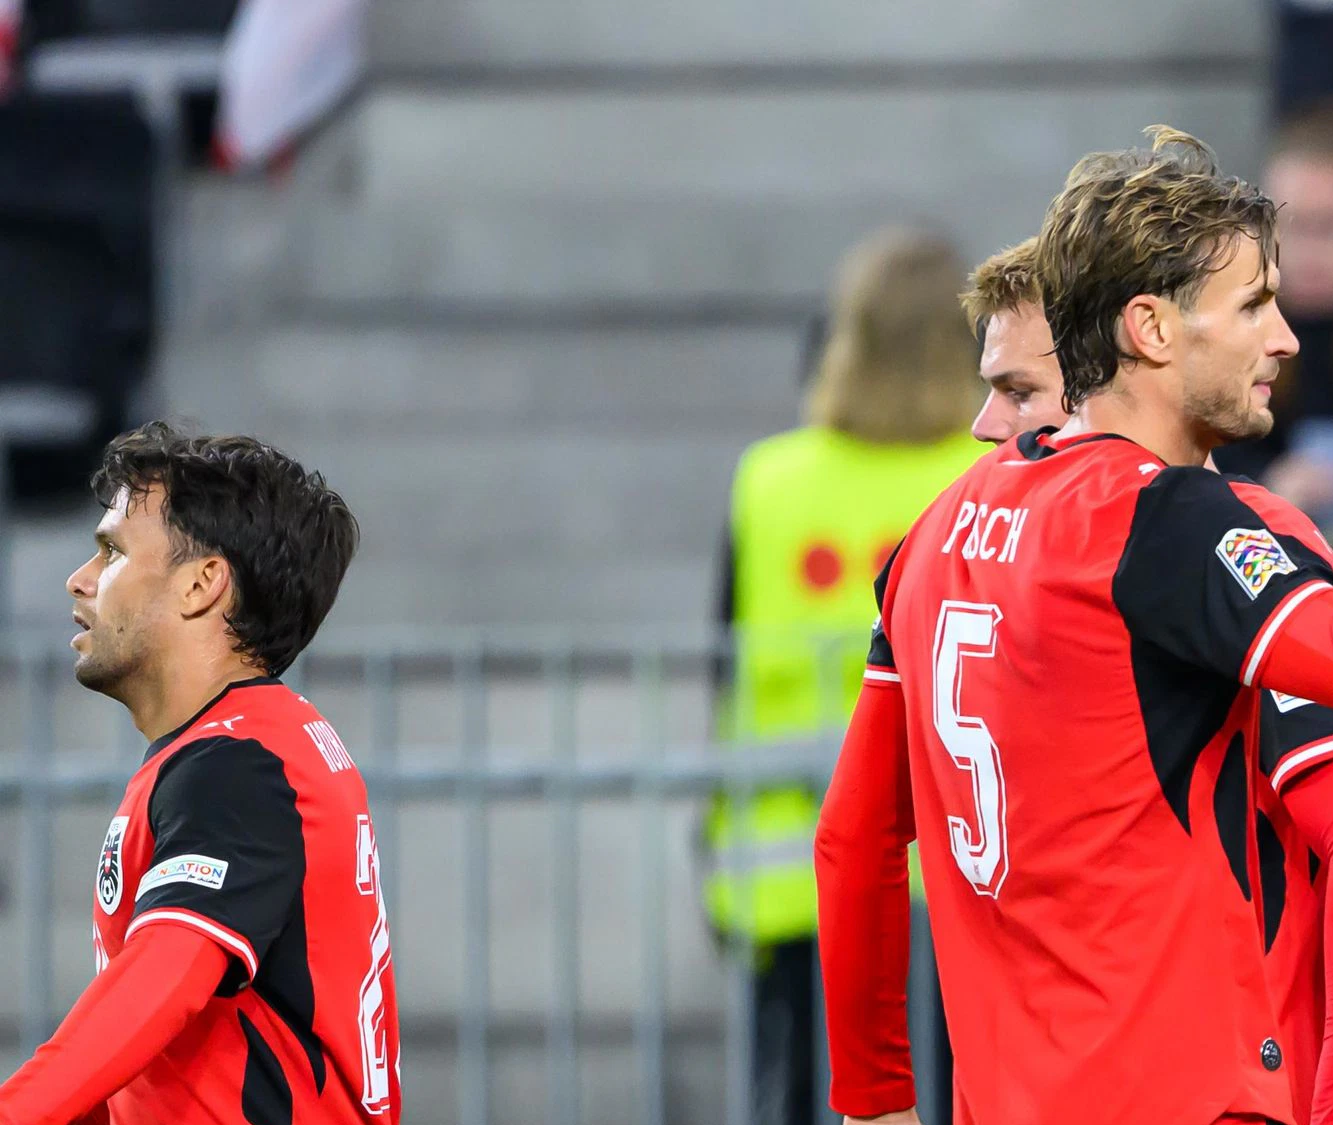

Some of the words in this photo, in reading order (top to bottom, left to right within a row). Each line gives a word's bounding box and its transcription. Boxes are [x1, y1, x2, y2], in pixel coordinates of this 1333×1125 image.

[941, 500, 1030, 563] PSCH
[932, 600, 1004, 899] 5
[355, 814, 401, 1114] 2
